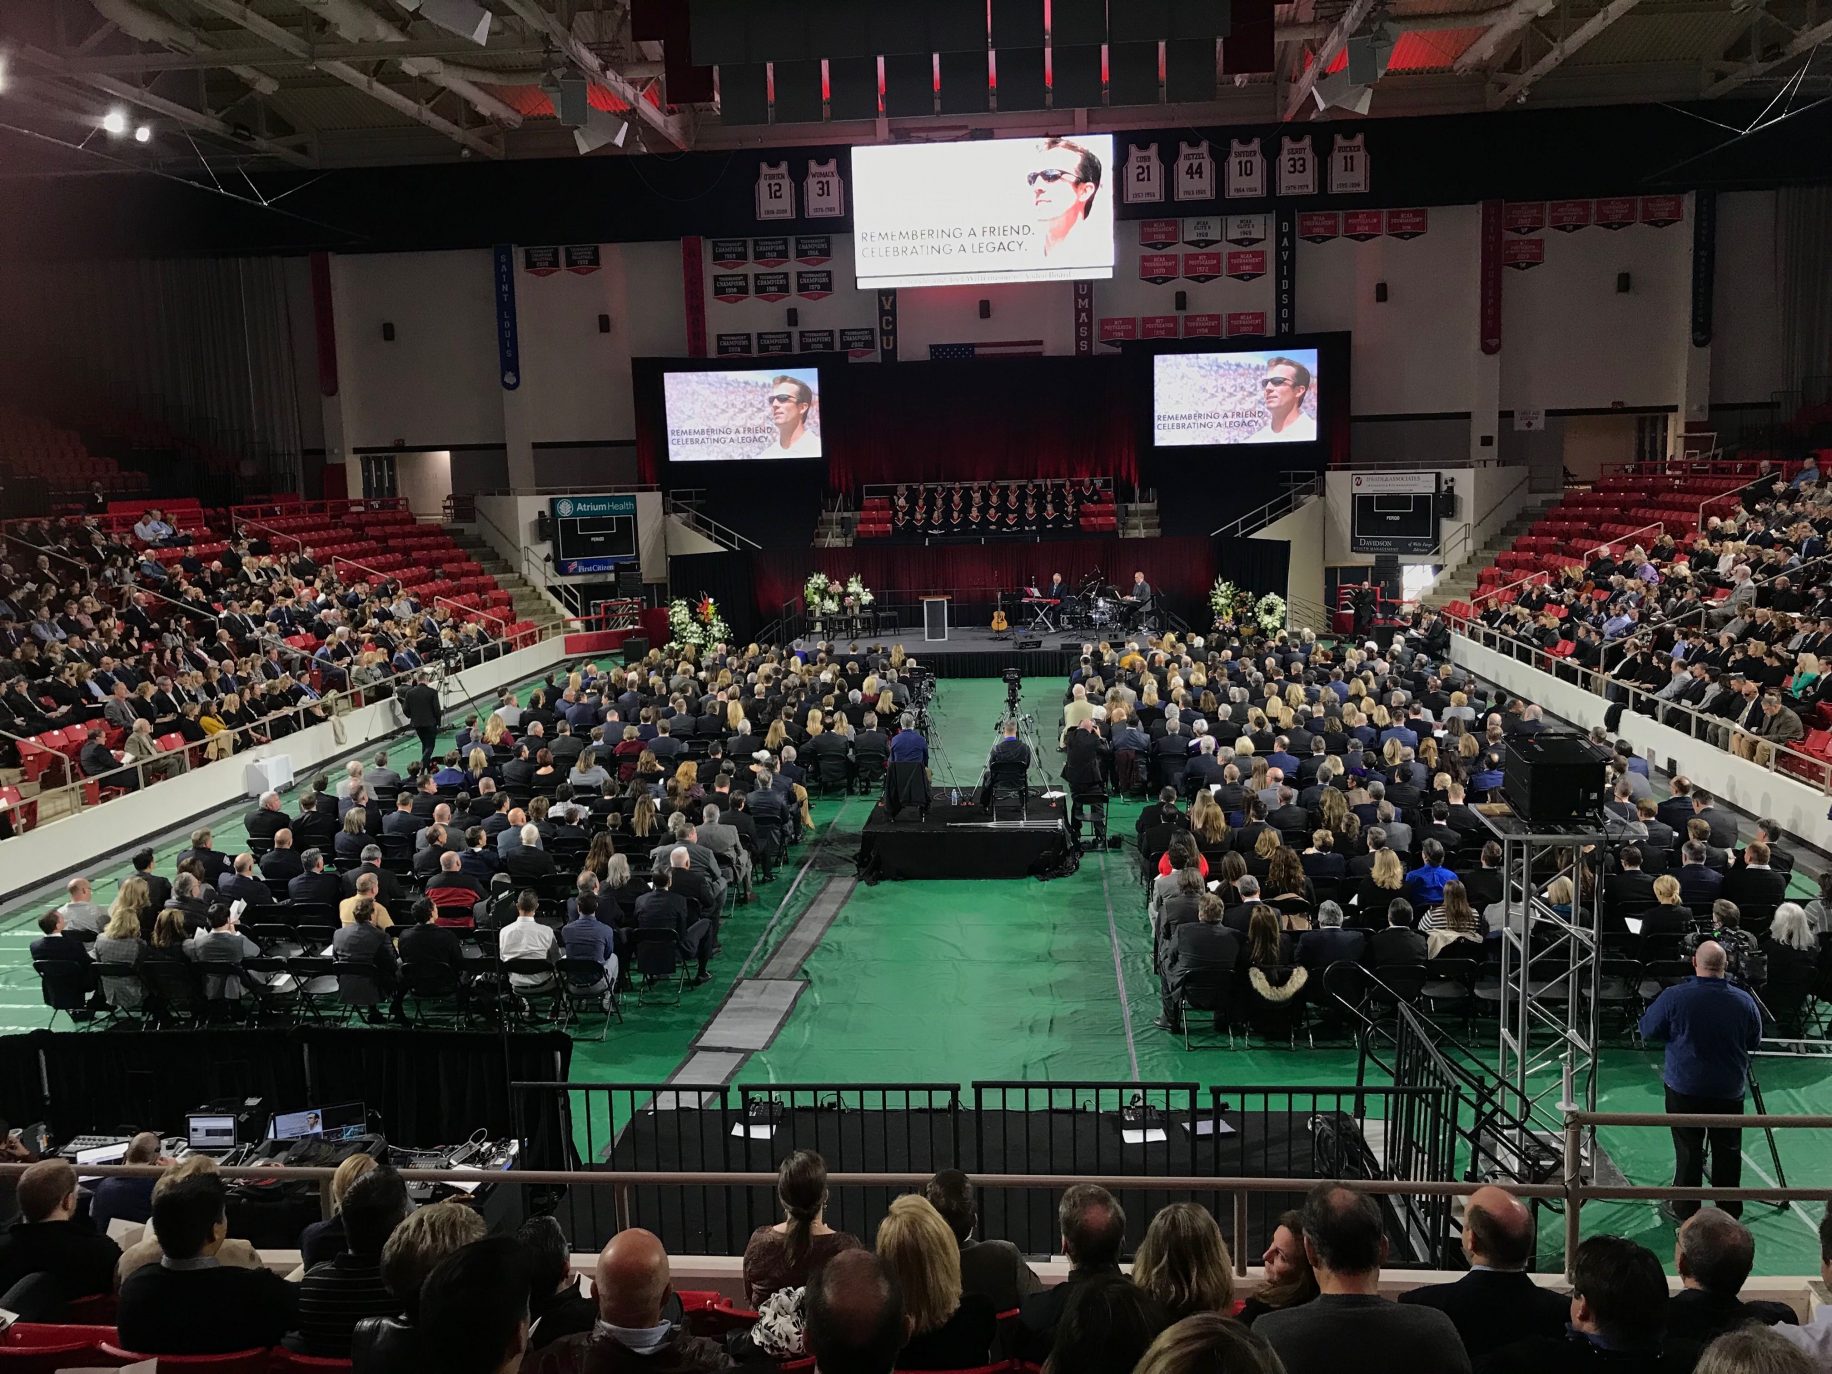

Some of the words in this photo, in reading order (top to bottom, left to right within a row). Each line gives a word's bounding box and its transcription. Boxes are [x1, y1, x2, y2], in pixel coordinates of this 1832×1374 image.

[1185, 162, 1203, 180] 44
[1238, 160, 1253, 177] 10
[1287, 157, 1306, 174] 33
[1343, 155, 1354, 172] 11
[1135, 164, 1151, 182] 21
[767, 182, 783, 200] 12
[816, 180, 831, 197] 31
[861, 227, 963, 243] REMEMBERING
[967, 227, 978, 238] A
[981, 224, 1035, 237] FRIEND.
[861, 243, 953, 258] CELEBRATING
[957, 243, 967, 254] A
[971, 240, 1028, 254] LEGACY.
[500, 254, 509, 302] SAINT
[1281, 222, 1289, 333] DAVIDSON
[881, 296, 894, 349] VCU
[1077, 284, 1089, 351] UMASS
[503, 311, 512, 358] LOUIS
[1157, 412, 1220, 421] REMEMBERING
[670, 428, 732, 437] REMEMBERING
[1156, 421, 1214, 431] CELEBRATING
[671, 437, 727, 446] CELEBRATING
[576, 502, 607, 512] Atrium
[607, 500, 635, 511] Health
